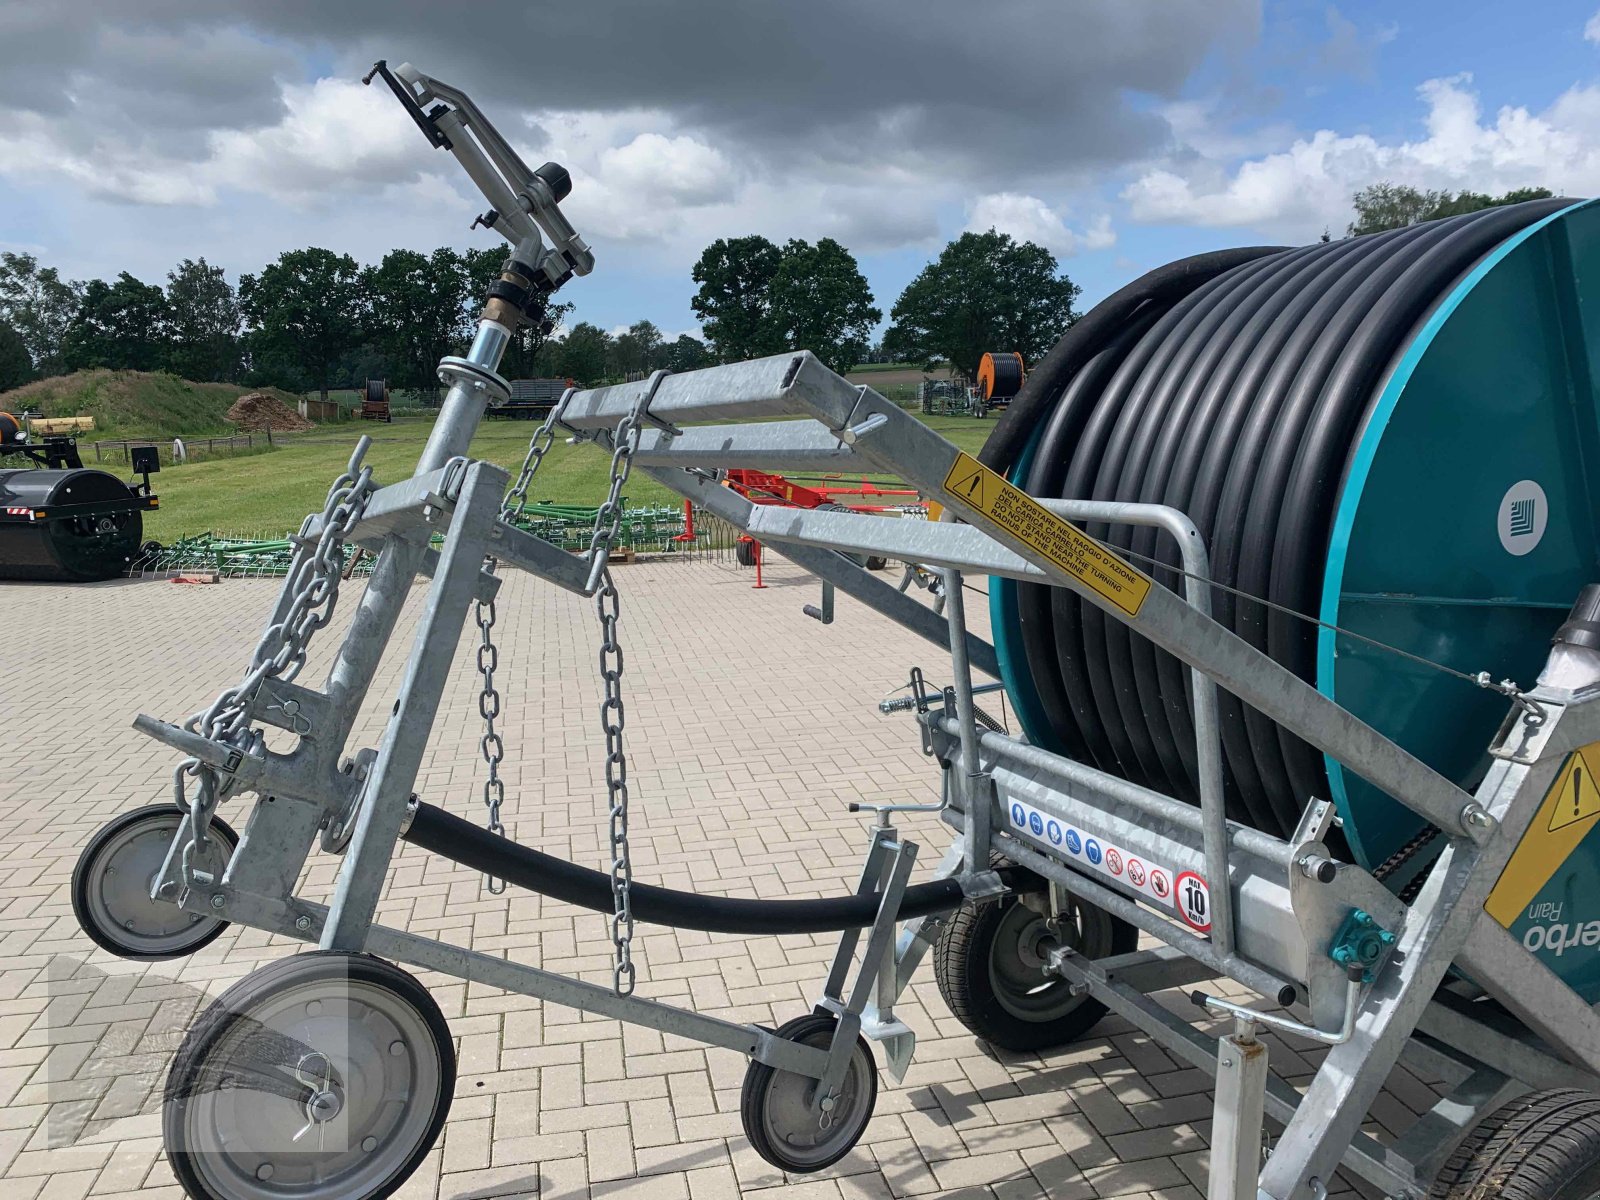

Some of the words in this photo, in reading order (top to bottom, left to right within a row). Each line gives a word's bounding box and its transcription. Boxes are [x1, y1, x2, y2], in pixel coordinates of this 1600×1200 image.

[990, 508, 1020, 531] RADIUS
[1020, 528, 1033, 539] OF
[1031, 536, 1049, 551] THE
[1049, 548, 1085, 575] MACHINE
[993, 501, 1007, 513] DO
[1007, 510, 1025, 525] NOT
[1024, 522, 1052, 544] STAND
[1051, 541, 1073, 559] NEAR
[1073, 556, 1090, 570] THE
[1089, 567, 1122, 592] TURNING
[997, 494, 1015, 508] DEL
[1014, 505, 1045, 529] CARICA
[1044, 526, 1085, 557] CARRELLO
[1001, 487, 1020, 503] NON
[1019, 500, 1056, 528] SOSTARE
[1056, 525, 1073, 539] NEL
[1072, 537, 1102, 560] RAGGIO
[1101, 557, 1136, 584] D'AZIONE
[1185, 887, 1205, 915] 10
[1188, 878, 1201, 889] MAX
[1528, 902, 1563, 923] Rain
[1523, 920, 1600, 956] erbo
